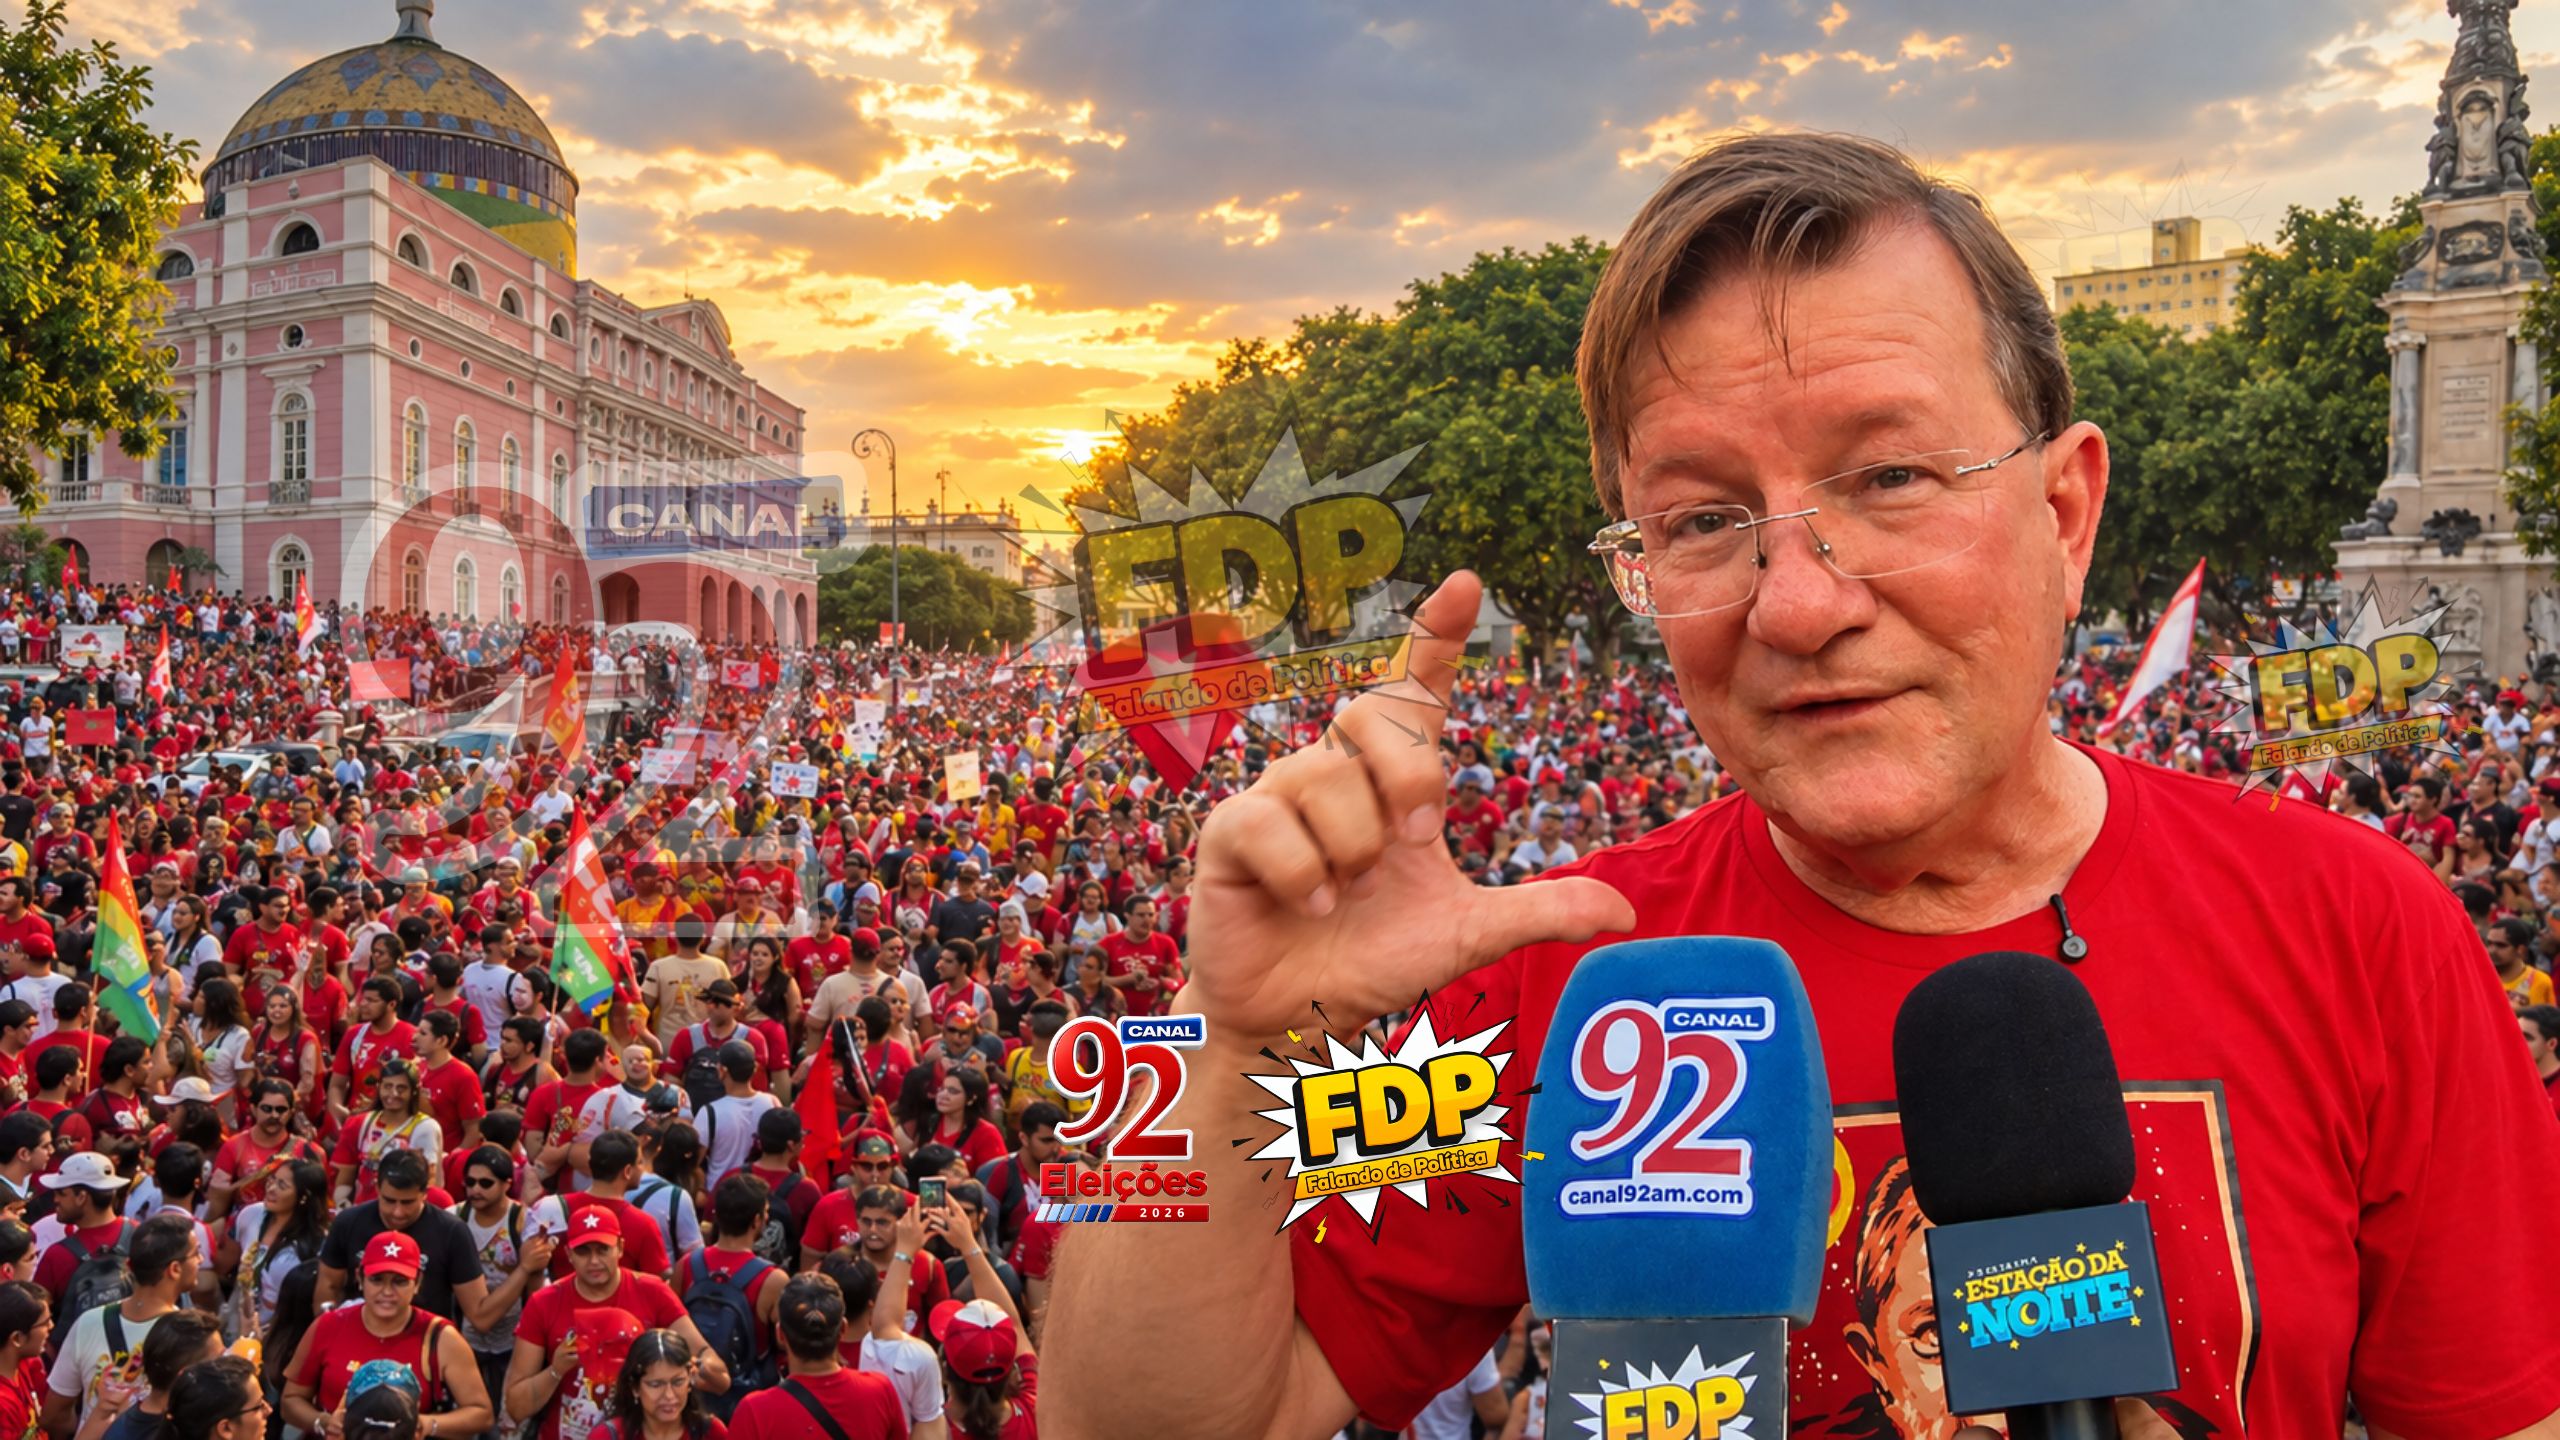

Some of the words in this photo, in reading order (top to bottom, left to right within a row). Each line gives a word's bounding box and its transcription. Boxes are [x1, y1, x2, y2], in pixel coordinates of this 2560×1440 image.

[1673, 1013, 1759, 1028] CANAL
[1581, 1008, 1743, 1175] 92
[1568, 1184, 1744, 1205] canal92am.com
[1965, 1255, 2086, 1303] ESTAÇÃO
[2087, 1249, 2129, 1277] DA
[1966, 1271, 2135, 1349] NOITE
[1604, 1375, 1746, 1440] FDP
